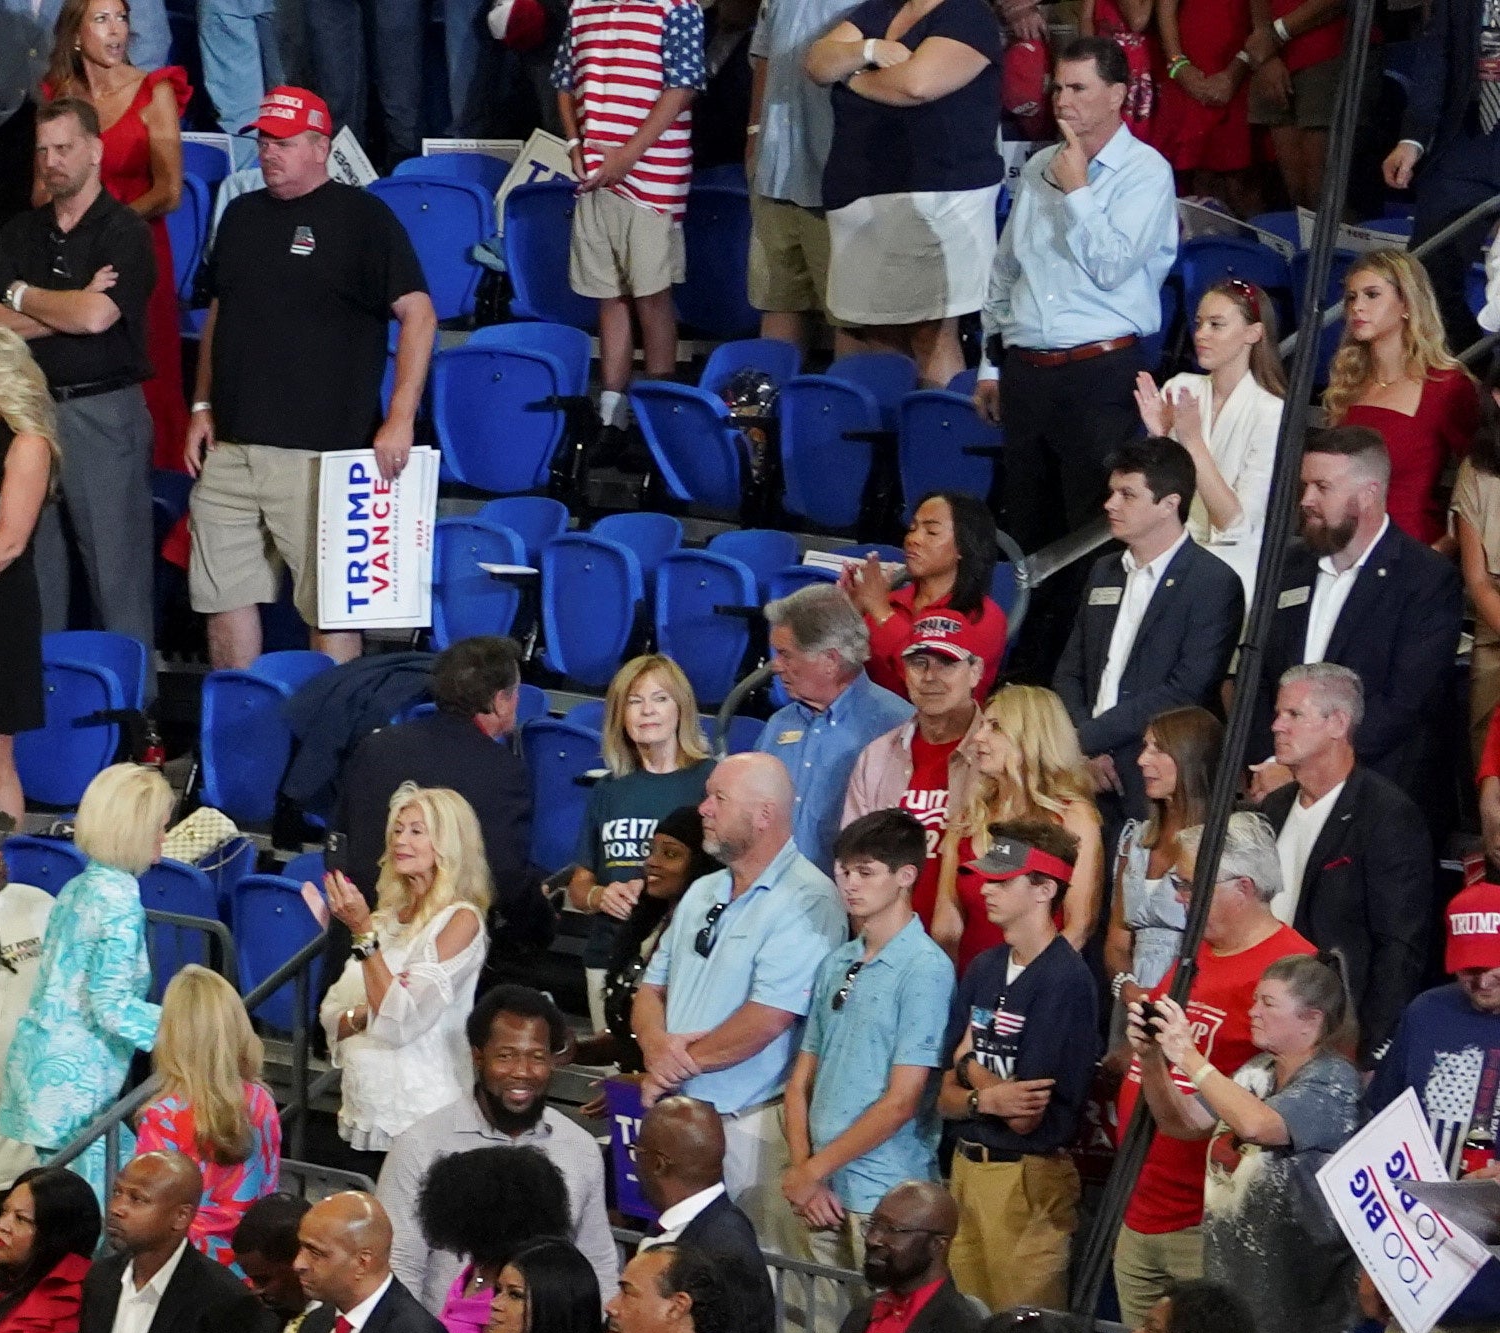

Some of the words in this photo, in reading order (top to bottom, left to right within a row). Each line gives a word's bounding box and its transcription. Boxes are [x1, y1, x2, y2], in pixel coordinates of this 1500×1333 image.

[348, 460, 371, 613] TRUMP
[373, 478, 392, 594] VANCE
[392, 534, 400, 574] AMERICA
[416, 519, 424, 549] 2024
[913, 617, 963, 635] TRUMP
[1450, 912, 1500, 935] TRUMP
[1347, 1168, 1387, 1231] BIG
[1375, 1231, 1429, 1306] TOO
